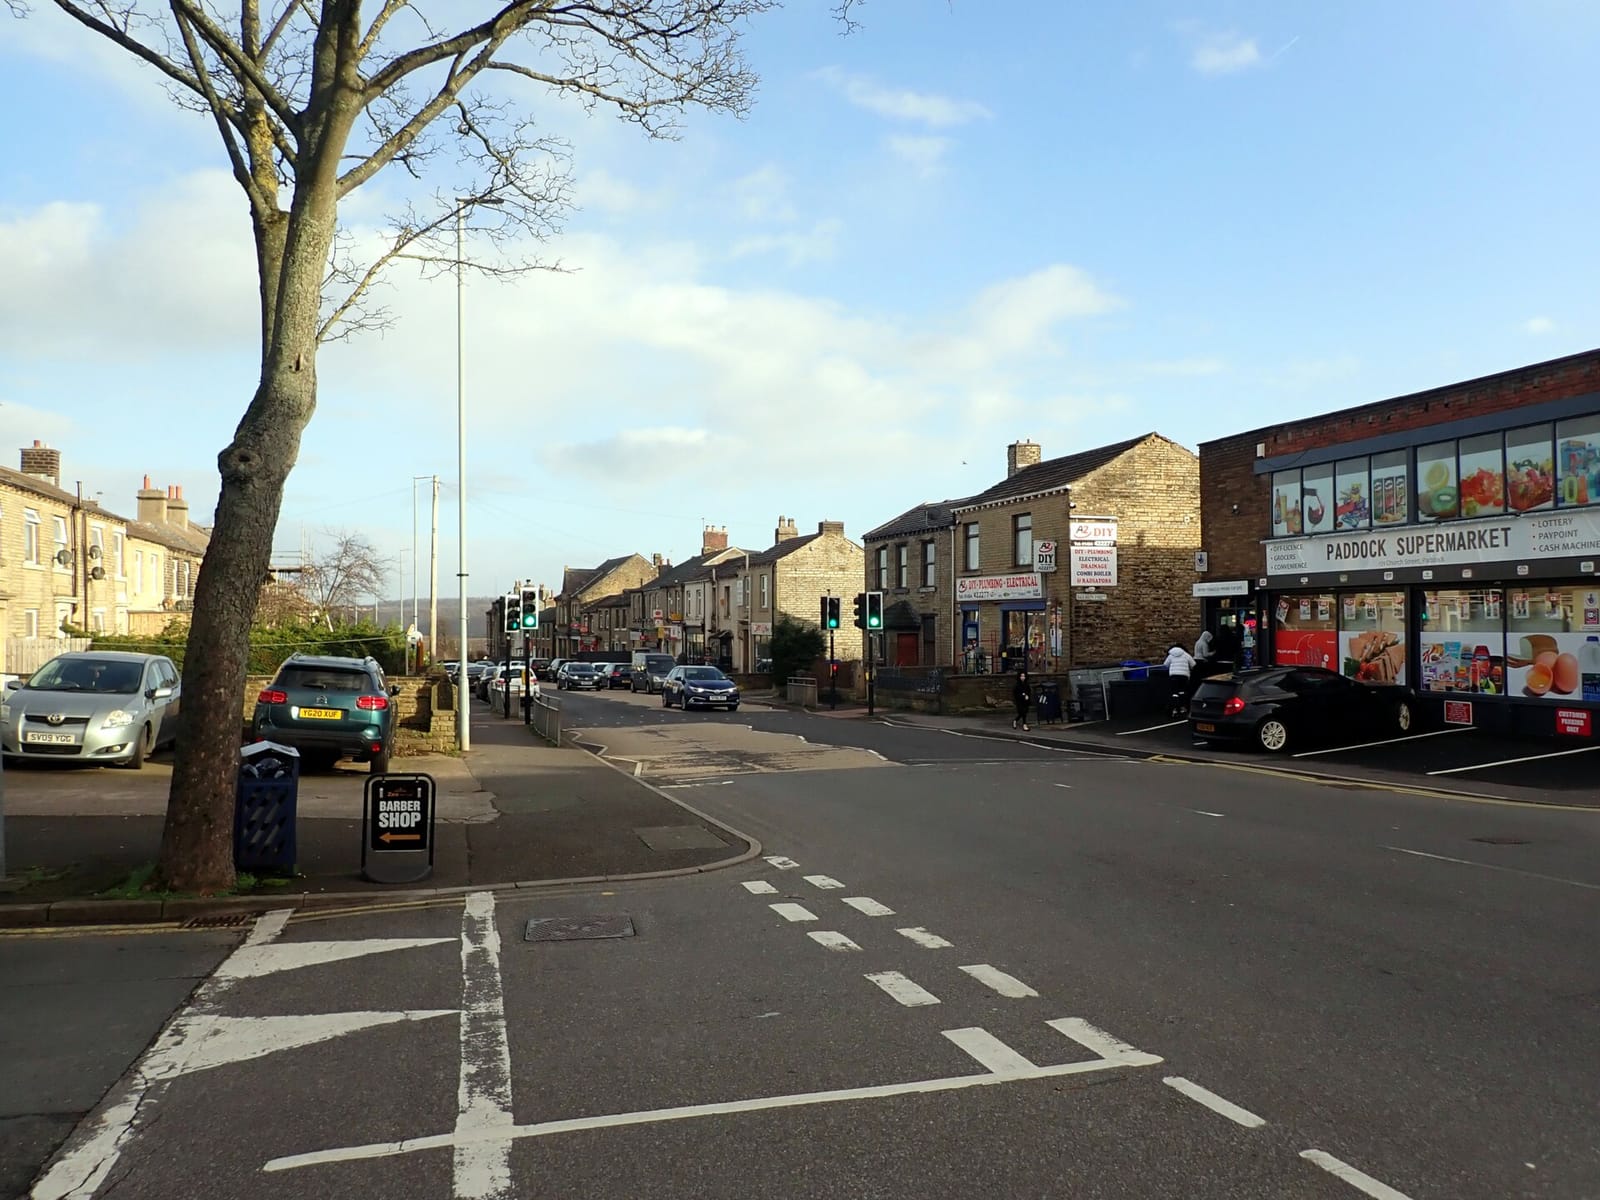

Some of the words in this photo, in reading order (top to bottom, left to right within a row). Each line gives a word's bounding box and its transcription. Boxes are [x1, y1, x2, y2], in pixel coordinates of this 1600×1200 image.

[1538, 518, 1573, 528] LOTTERY
[1094, 528, 1113, 537] DIY
[1538, 529, 1578, 540] PAYPOINT
[1273, 544, 1303, 552] OFF-LICENCE
[1327, 539, 1387, 560] PADDOCK
[1397, 527, 1511, 556] SUPERMARKET
[1539, 544, 1560, 552] CASH
[1038, 554, 1053, 563] DIY
[1273, 562, 1308, 571] CONVENIENCE
[969, 580, 977, 589] DIY
[979, 578, 1002, 589] PLUMBING
[1006, 576, 1038, 588] ELECTRICAL
[1558, 711, 1587, 719] CUSTOMER
[31, 734, 53, 742] SV09
[379, 801, 421, 811] BARBER
[379, 812, 421, 828] SHOP
